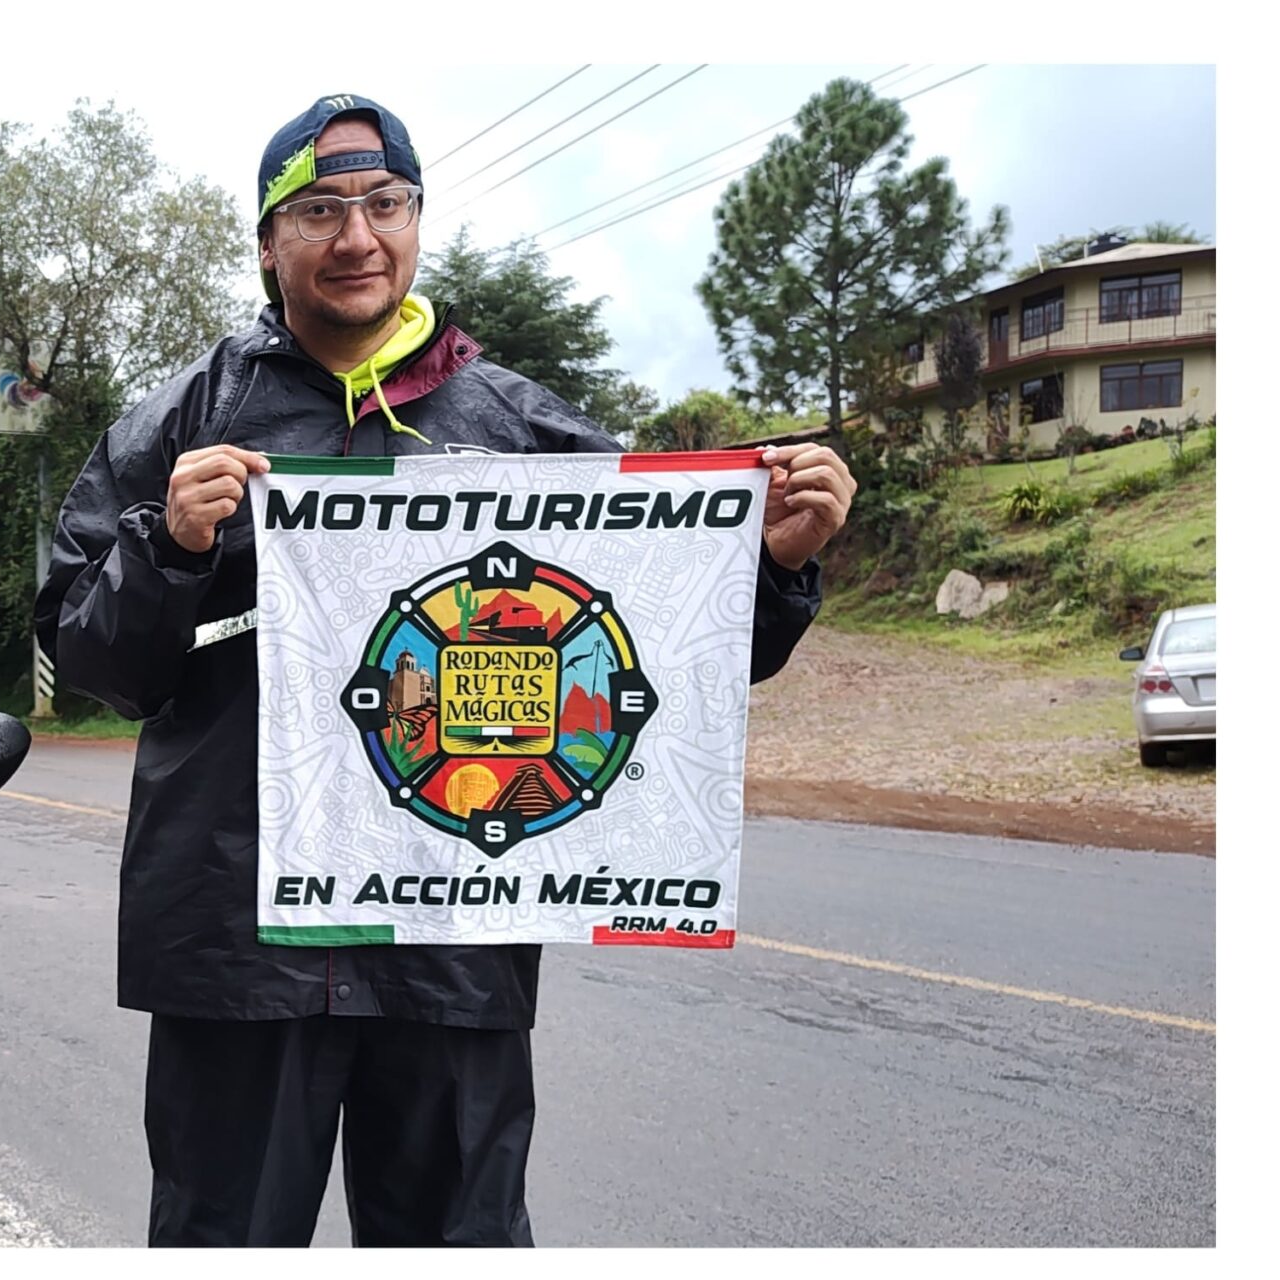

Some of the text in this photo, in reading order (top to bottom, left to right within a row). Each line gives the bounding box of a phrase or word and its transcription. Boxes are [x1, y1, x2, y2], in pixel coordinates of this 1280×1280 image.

[486, 557, 517, 578] N
[352, 687, 380, 708] O
[621, 691, 645, 712] E
[484, 820, 507, 843] S
[273, 866, 721, 909] EN ACCIÓN MÉXICO
[610, 915, 718, 935] RRM 4.0
